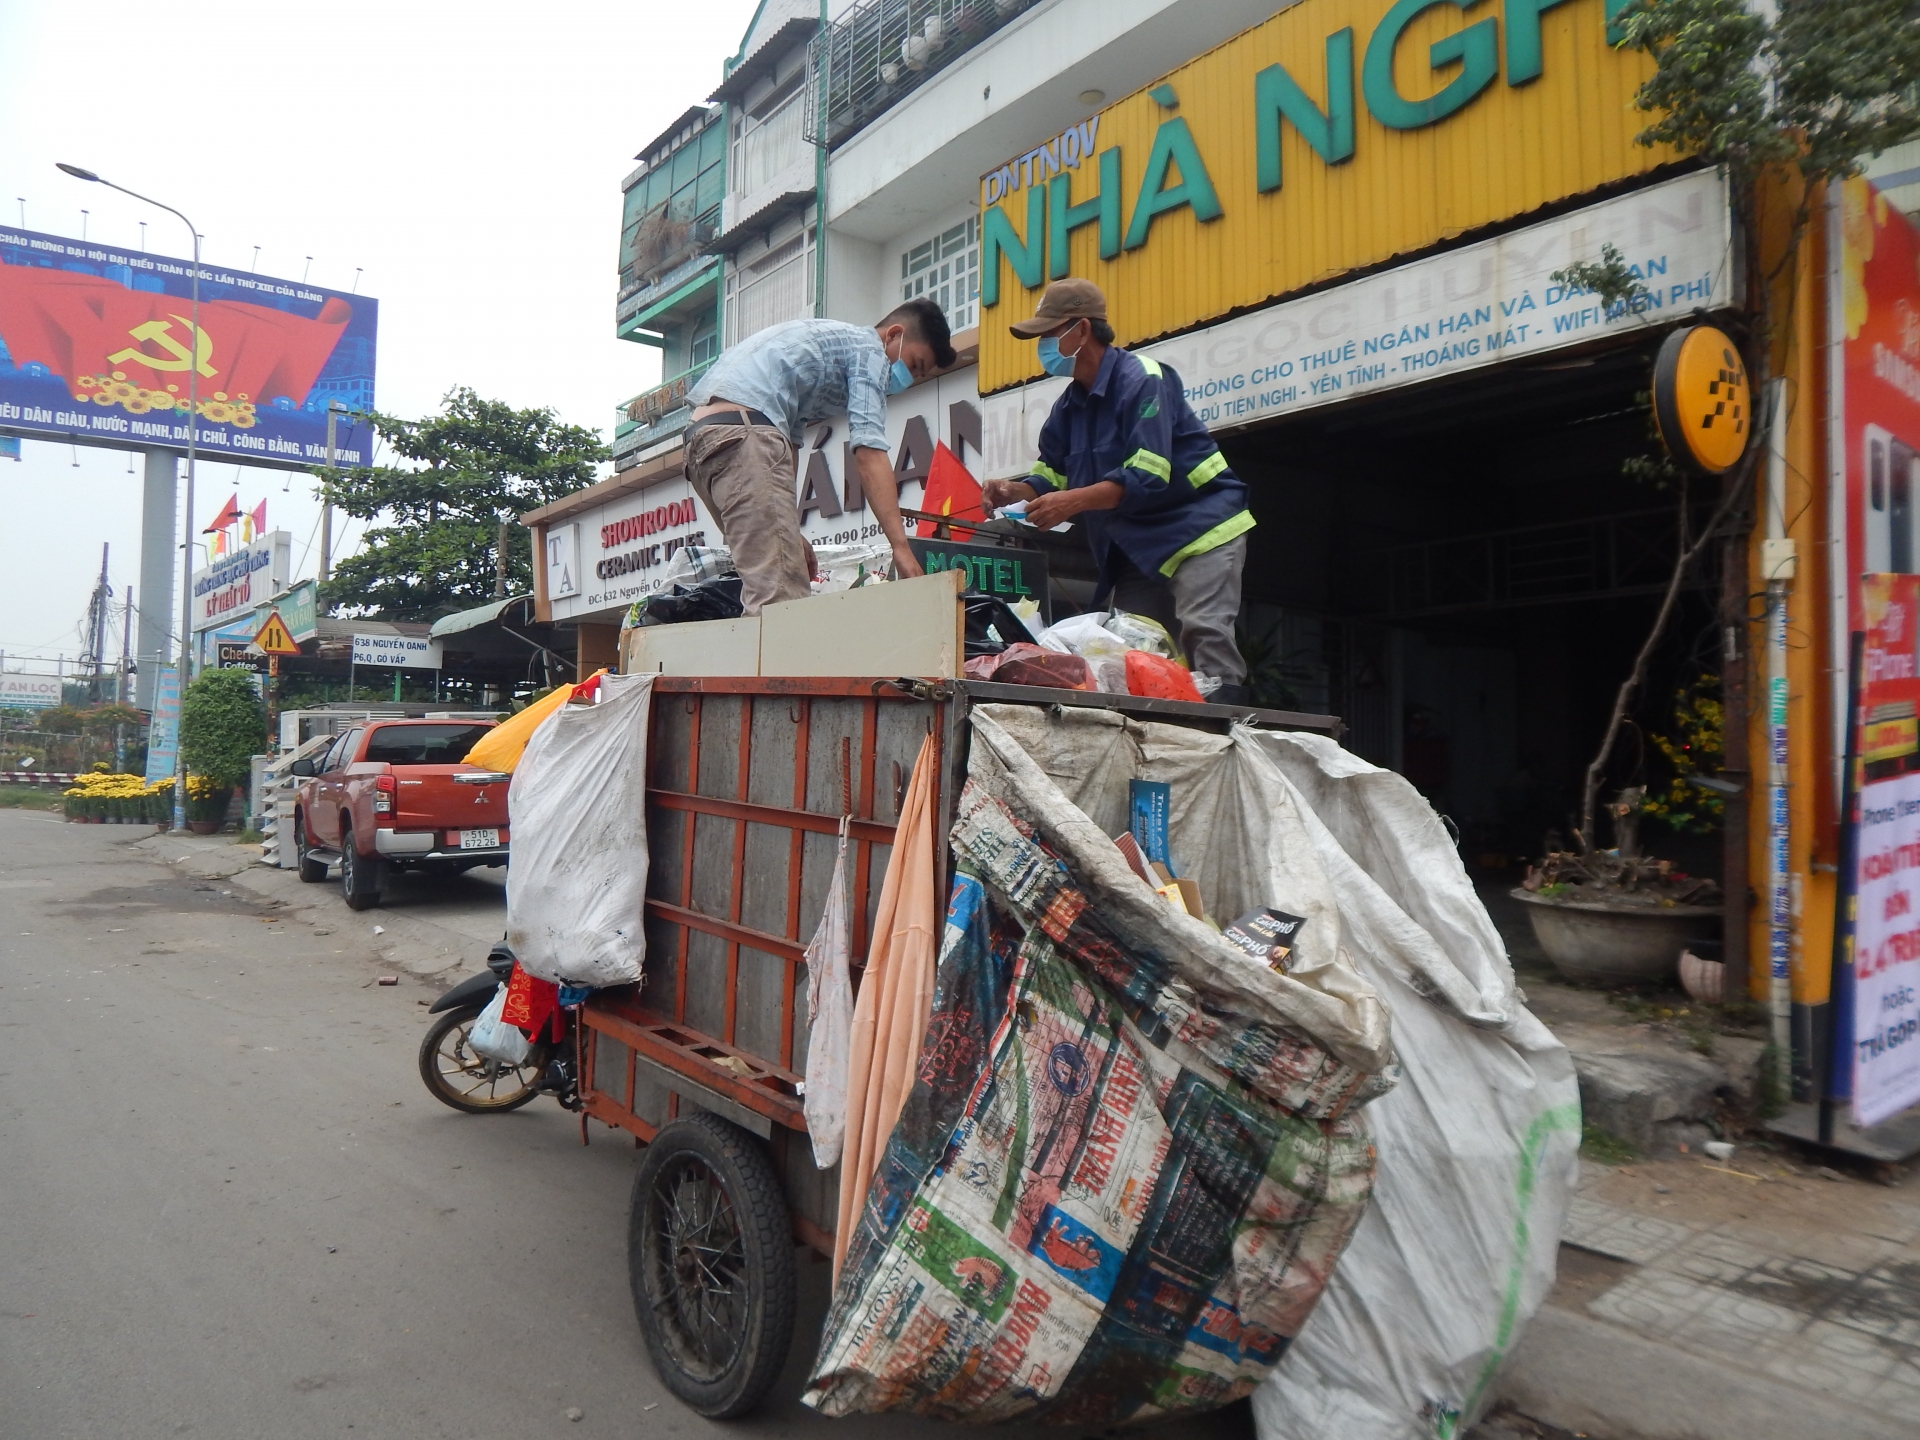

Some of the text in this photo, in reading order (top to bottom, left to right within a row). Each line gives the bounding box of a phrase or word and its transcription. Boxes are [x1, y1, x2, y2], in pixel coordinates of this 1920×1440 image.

[985, 115, 1100, 206] DNTNQV
[977, 84, 1224, 308] NHÀ
[157, 262, 183, 275] TOÀN
[186, 269, 213, 281] QỐC
[1224, 396, 1256, 417] TIỆN
[1260, 385, 1298, 407] NGHI
[1310, 374, 1343, 396] YÊN
[1401, 339, 1481, 374] THOÁNG
[1487, 323, 1531, 352] MÁT
[1553, 306, 1599, 334] WIFI
[1670, 271, 1712, 305] PHÍ
[1250, 361, 1295, 385] CHO
[1300, 340, 1357, 373] THUÊ
[1438, 305, 1492, 335] HẠN
[1500, 289, 1538, 318] VÀ
[0, 402, 20, 419] IÊU
[24, 407, 52, 424] DÂN
[56, 410, 91, 430] GIÀU,
[93, 415, 129, 433] NƯỚC
[131, 420, 172, 440] MẠNH,
[202, 427, 230, 447] CHỦ,
[233, 433, 266, 451] CÔNG
[305, 443, 329, 459] VĂN
[601, 497, 698, 549] SHOWROOM
[834, 529, 858, 545] 090
[549, 535, 562, 567] T
[596, 543, 661, 580] CERAMIC
[559, 562, 574, 594] A
[926, 550, 1032, 595] MOTEL
[604, 589, 618, 603] 632
[620, 578, 651, 601] Nguyễn
[354, 637, 371, 647] 638
[406, 641, 427, 651] OANH
[465, 838, 496, 848] 672.26
[471, 830, 488, 839] 51D
